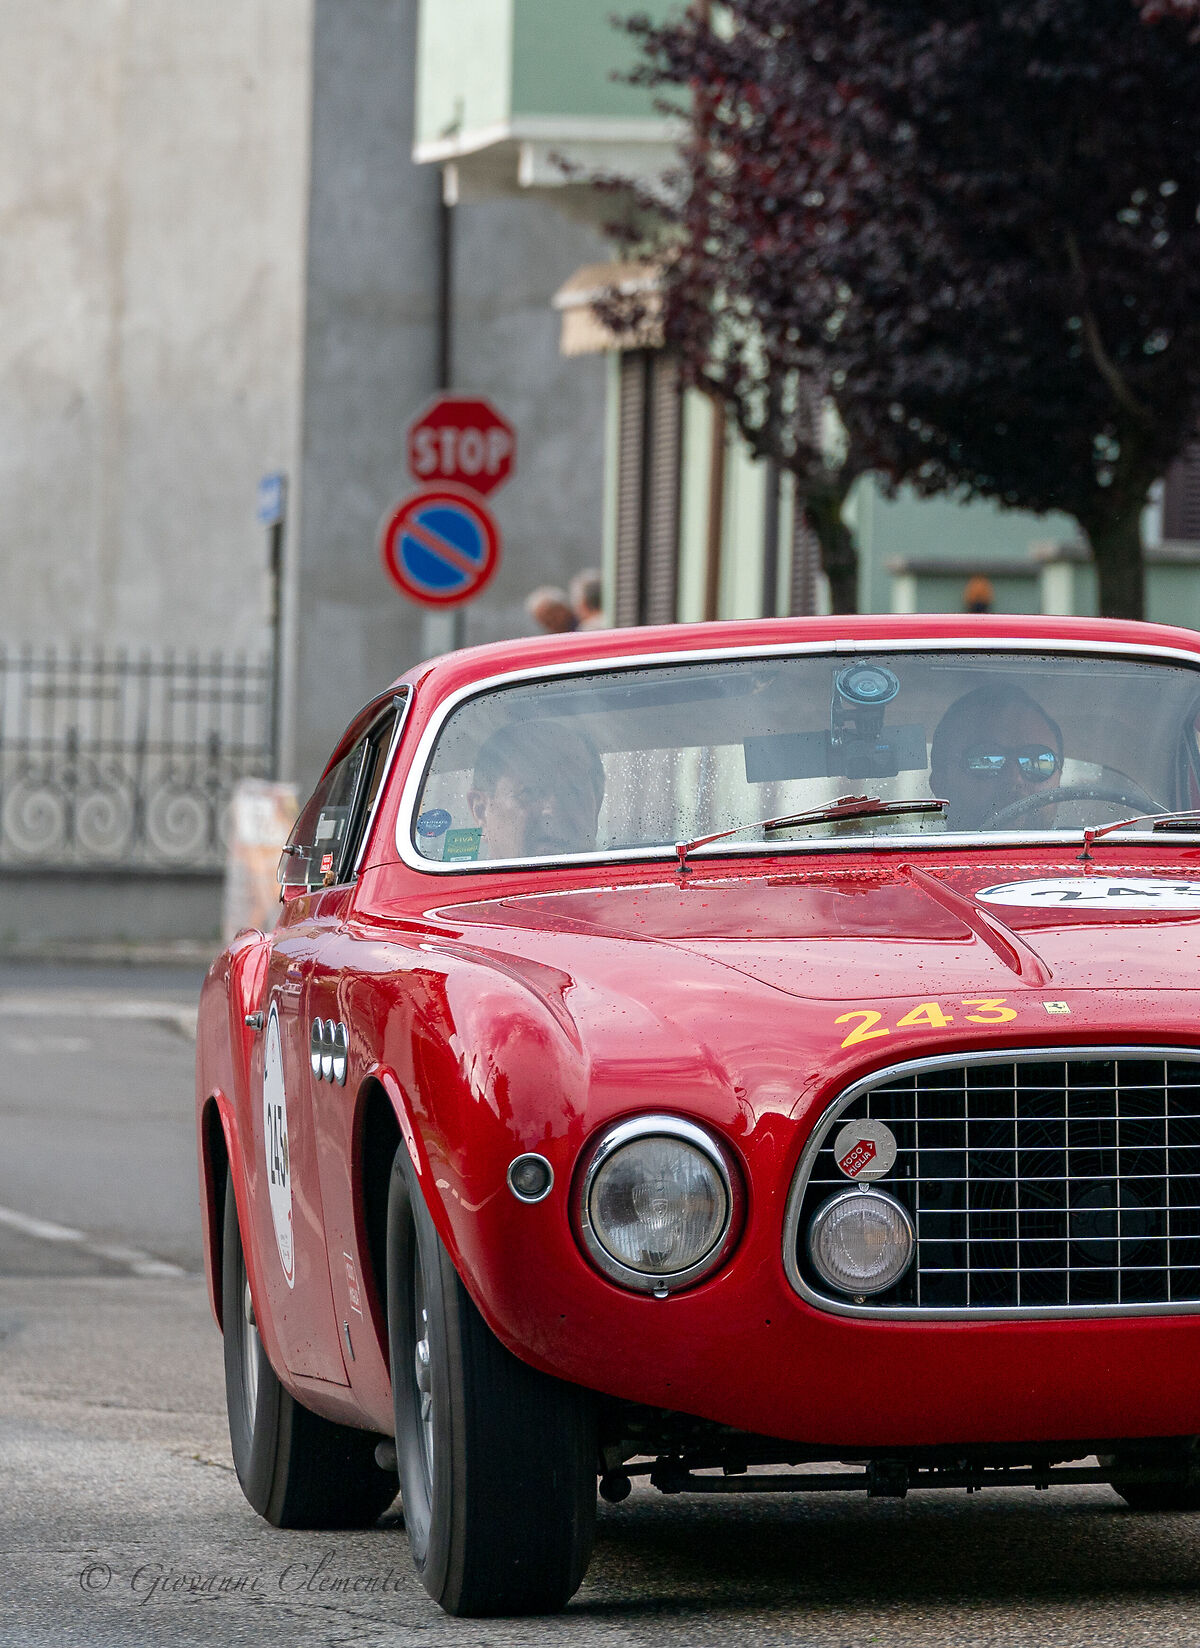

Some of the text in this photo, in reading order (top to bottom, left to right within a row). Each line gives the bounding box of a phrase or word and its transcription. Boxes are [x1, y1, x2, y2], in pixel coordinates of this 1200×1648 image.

[413, 426, 510, 476] STOP
[834, 998, 1018, 1049] 243
[267, 1103, 286, 1188] 243
[843, 1147, 863, 1168] 1000
[848, 1152, 871, 1176] MIGLIA
